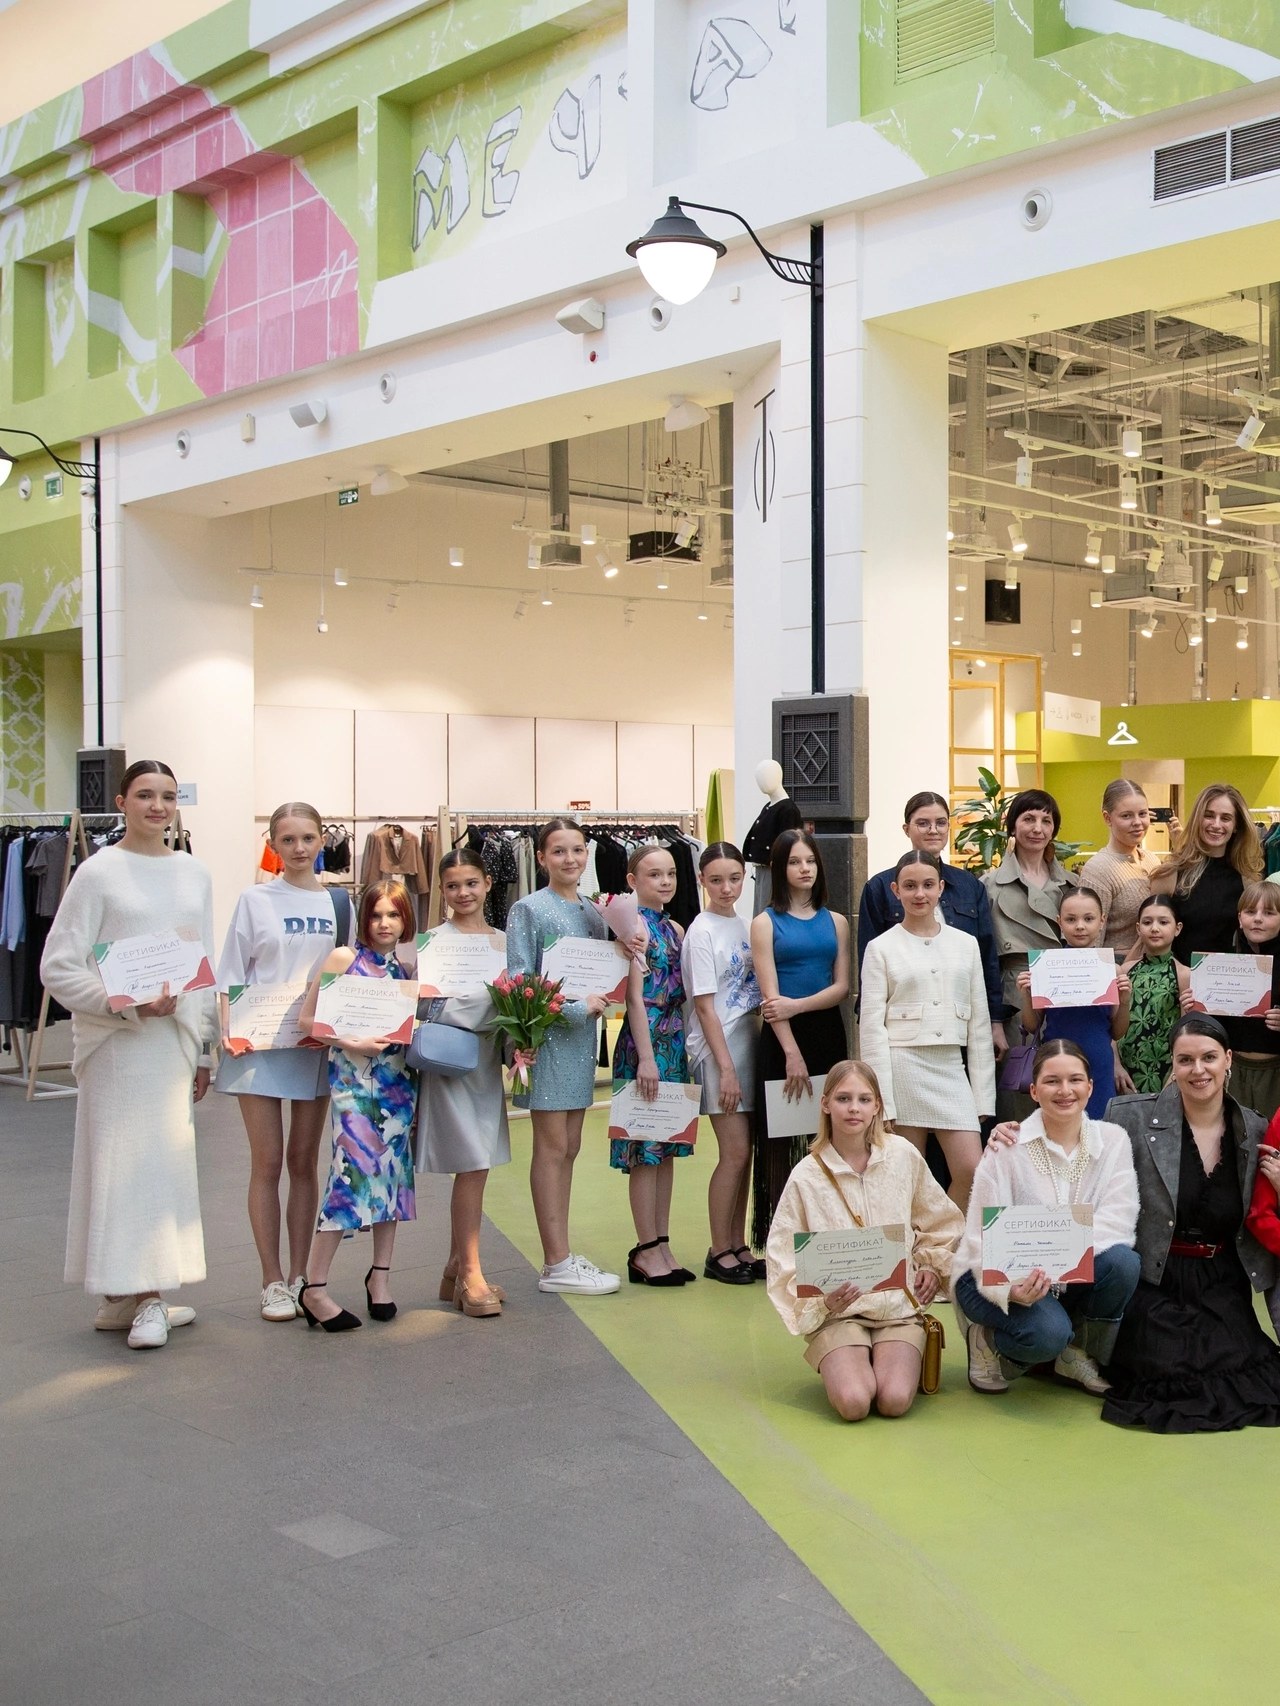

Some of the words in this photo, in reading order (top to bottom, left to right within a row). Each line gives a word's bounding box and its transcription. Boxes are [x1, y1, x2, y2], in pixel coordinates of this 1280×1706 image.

[117, 939, 181, 961] СЕРТИФИКАТ
[435, 945, 490, 953] СЕРТИФИКАТ
[561, 947, 614, 959] СЕРТИФИКАТ
[1045, 958, 1099, 967] СЕРТИФИКАТ
[1206, 965, 1257, 974] СЕРТИФИКАТ
[338, 985, 400, 998] СЕРТИФИКАТ
[248, 994, 308, 1004] СЕРТИФИКАТ
[1003, 1218, 1073, 1230] СЕРТИФИКАТ
[816, 1237, 885, 1252] СЕРТИФИКАТ
